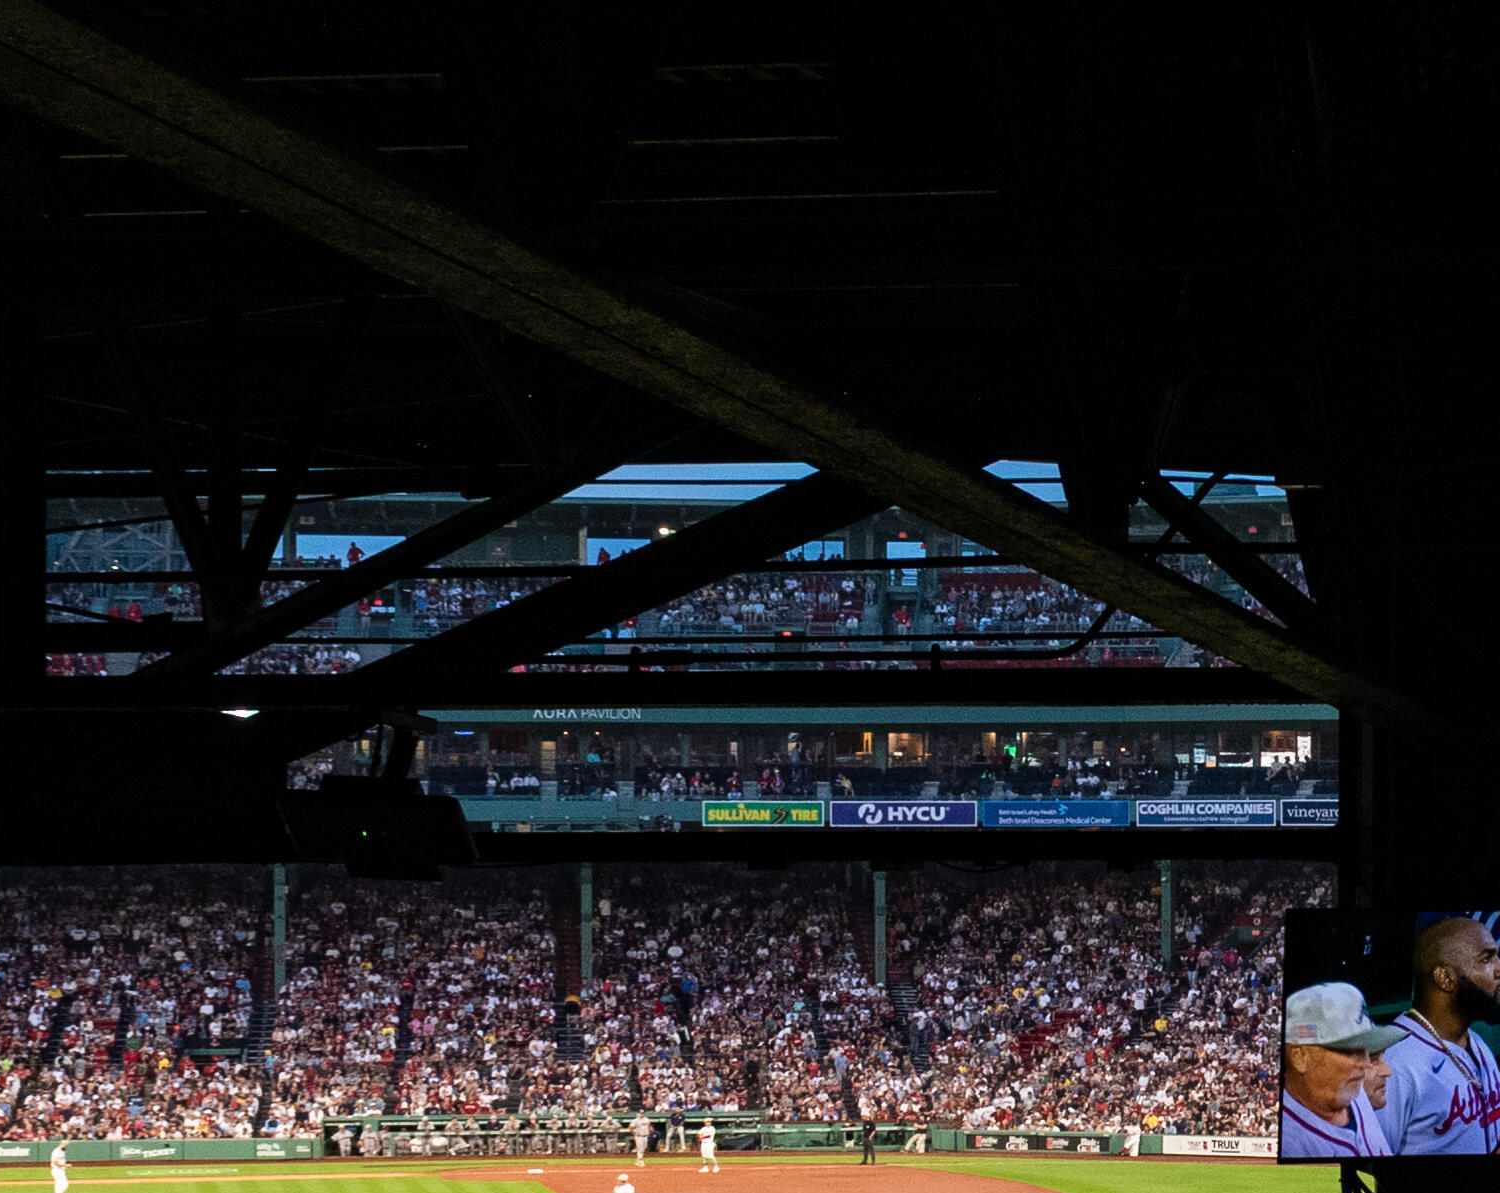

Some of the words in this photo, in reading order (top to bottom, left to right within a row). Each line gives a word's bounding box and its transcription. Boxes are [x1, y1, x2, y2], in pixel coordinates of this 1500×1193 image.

[581, 707, 641, 719] PAVILION
[707, 807, 770, 821] SULLIVAN
[791, 808, 819, 821] TIRE
[887, 806, 946, 821] HYCU
[1139, 803, 1195, 815] COGHLIN
[1196, 803, 1273, 815] COMPANIES
[998, 817, 1013, 825] Beth
[1014, 817, 1031, 825] Israel
[1032, 817, 1064, 825] Deaconess
[1065, 816, 1089, 825] Medical
[1090, 817, 1112, 825] Center
[1211, 1139, 1241, 1151] TRULY
